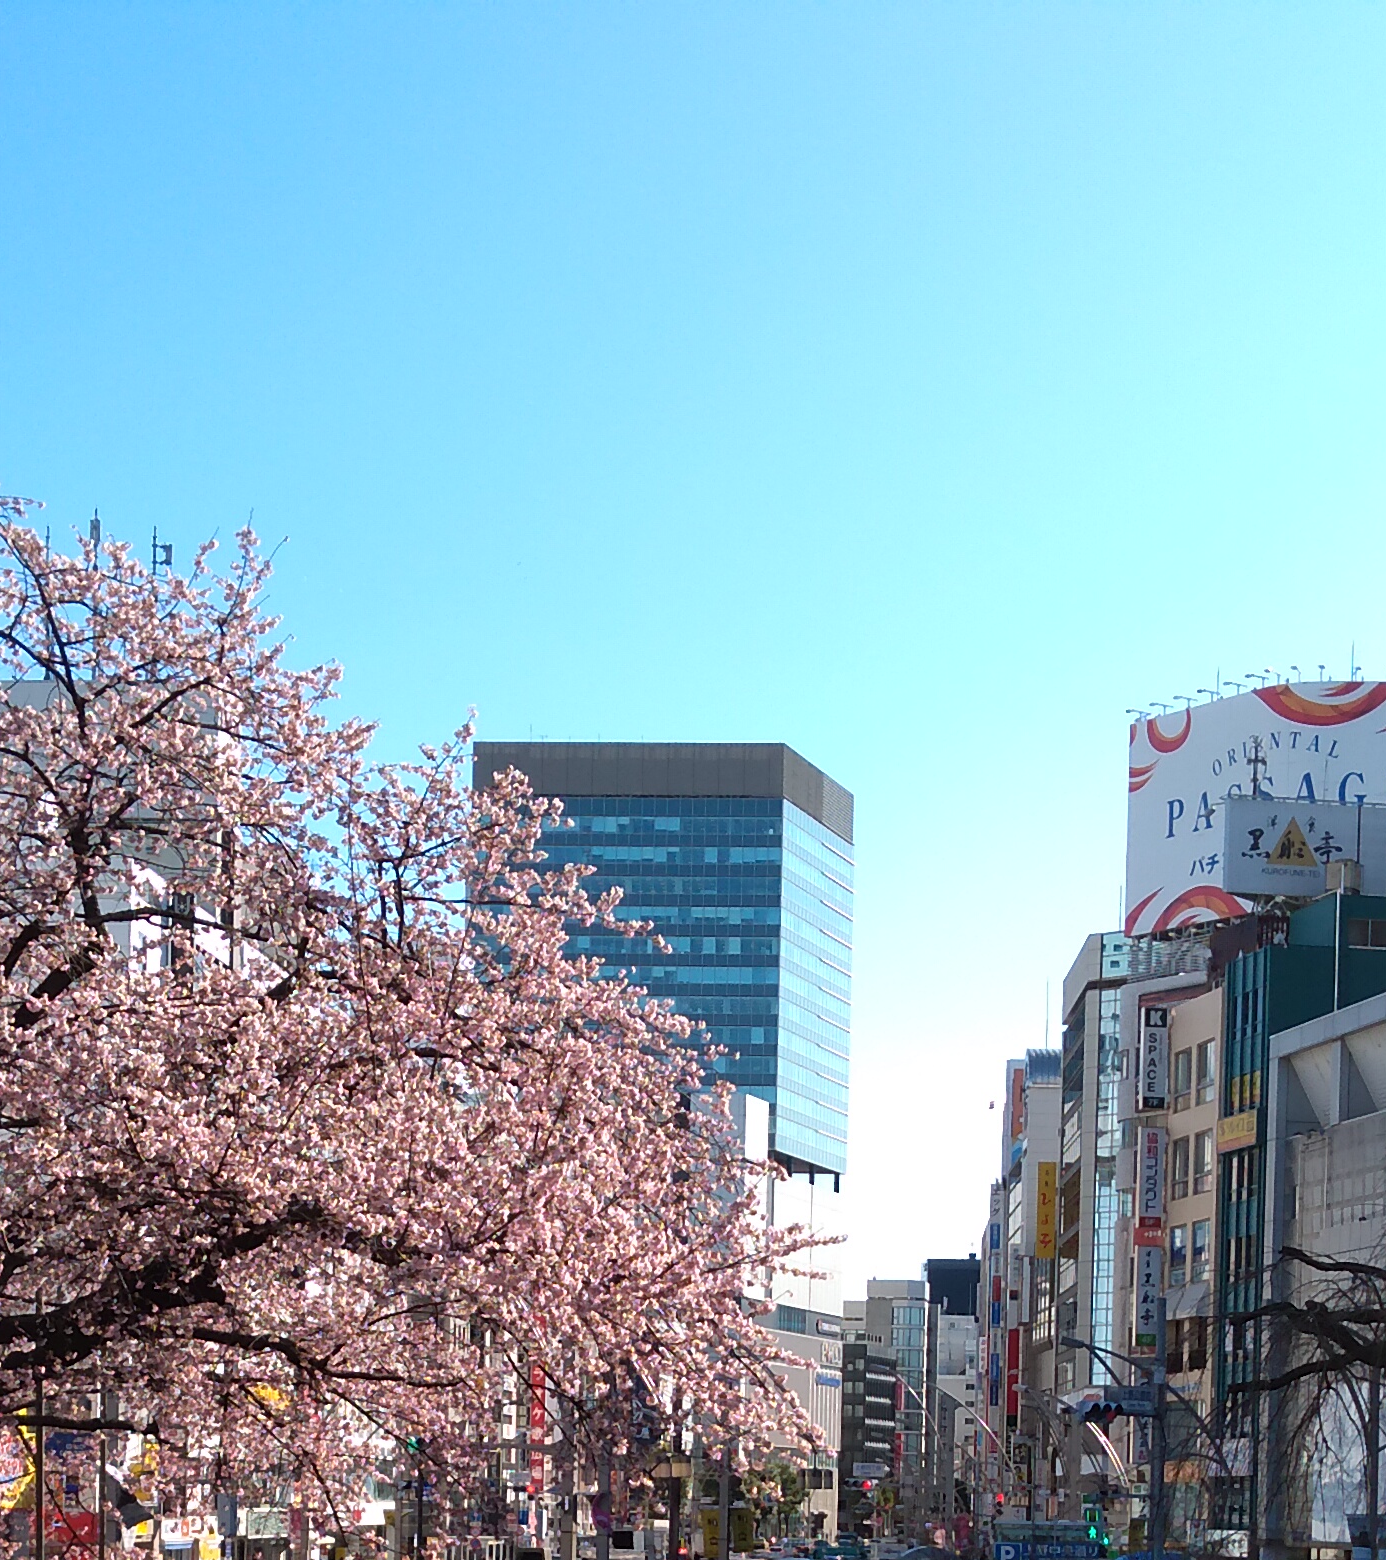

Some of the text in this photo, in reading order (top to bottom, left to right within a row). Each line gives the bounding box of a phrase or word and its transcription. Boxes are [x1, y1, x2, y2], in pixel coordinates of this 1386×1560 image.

[1212, 731, 1340, 777] ORINTAL
[1240, 827, 1344, 865] 黒船亭
[1149, 1010, 1163, 1026] K
[1146, 1032, 1159, 1093] SPACE
